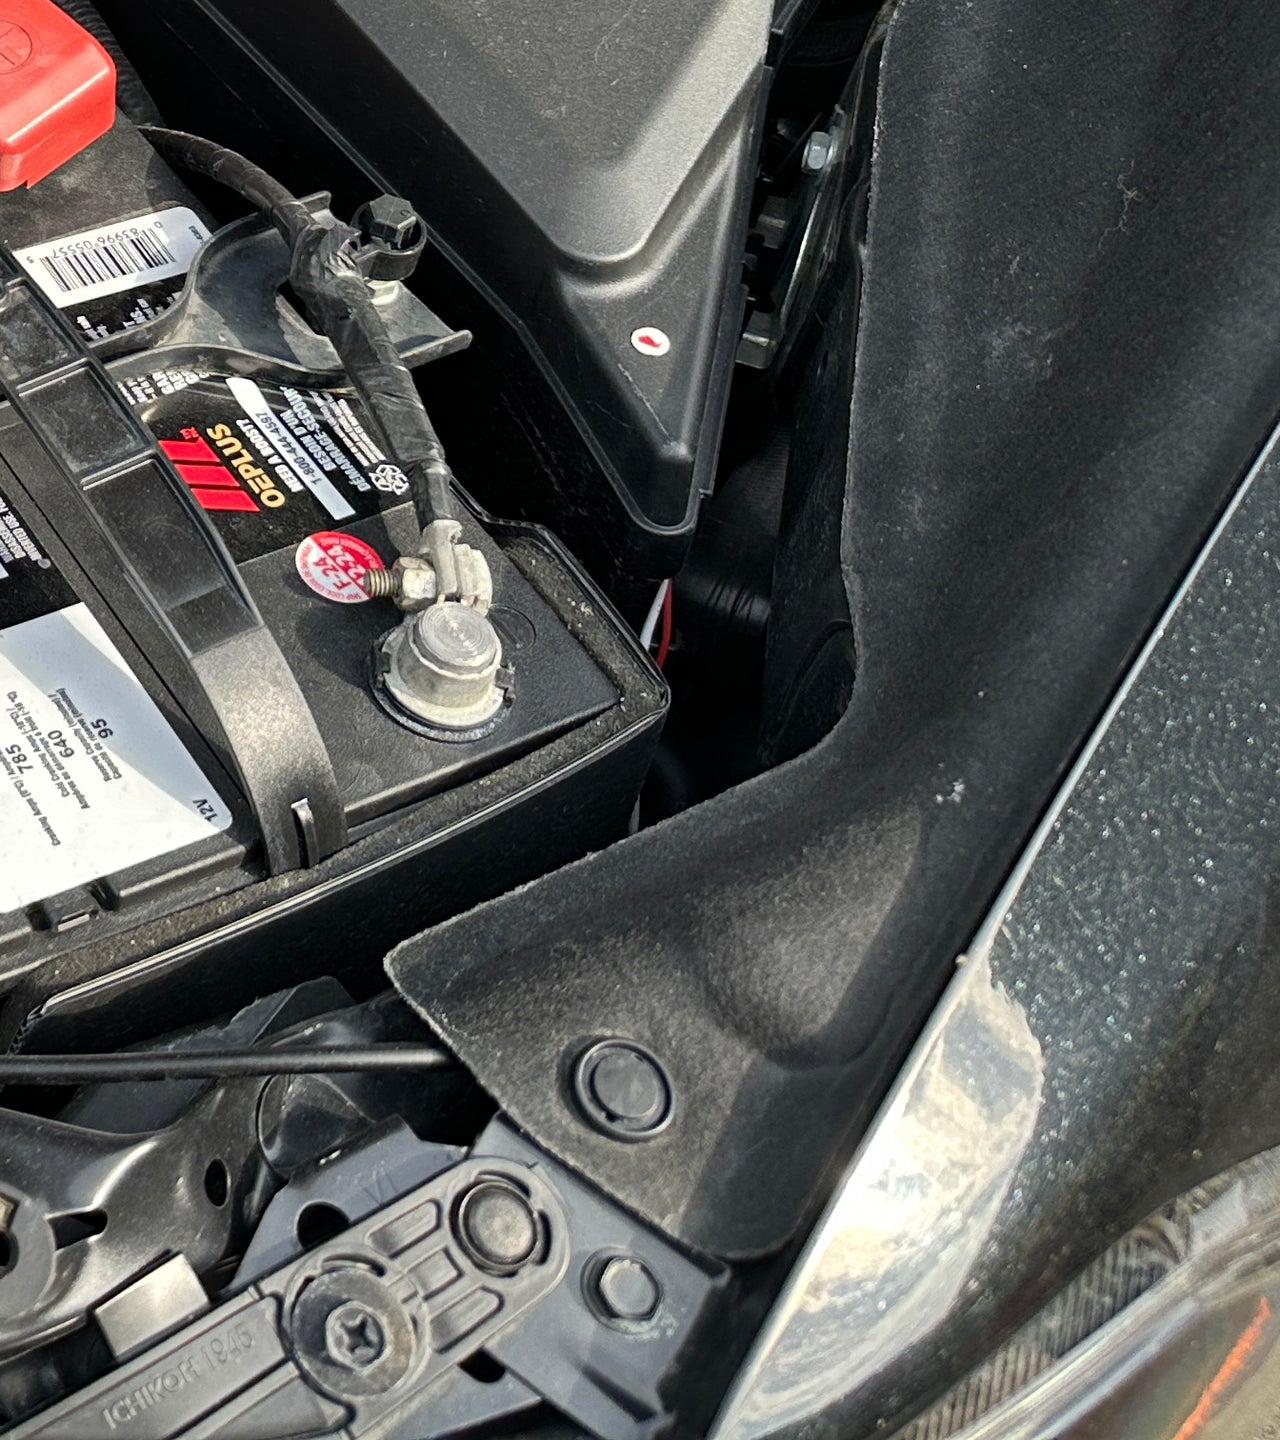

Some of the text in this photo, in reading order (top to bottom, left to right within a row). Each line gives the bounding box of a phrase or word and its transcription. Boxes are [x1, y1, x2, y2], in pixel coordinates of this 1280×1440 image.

[49, 239, 94, 258] 05557
[97, 226, 140, 245] 83996
[25, 255, 35, 264] 5
[278, 408, 310, 436] D'UN
[234, 416, 305, 492] NEED A BOOST?
[254, 410, 323, 485] 1-800-444-4597
[298, 434, 338, 471] BESOIN
[203, 421, 290, 510] OEPLUS
[312, 552, 346, 591] F-24
[46, 728, 75, 759] 640
[89, 717, 114, 740] 95
[4, 742, 34, 774] 785
[191, 795, 219, 823] 12V
[98, 1354, 205, 1430] ICHIKOH
